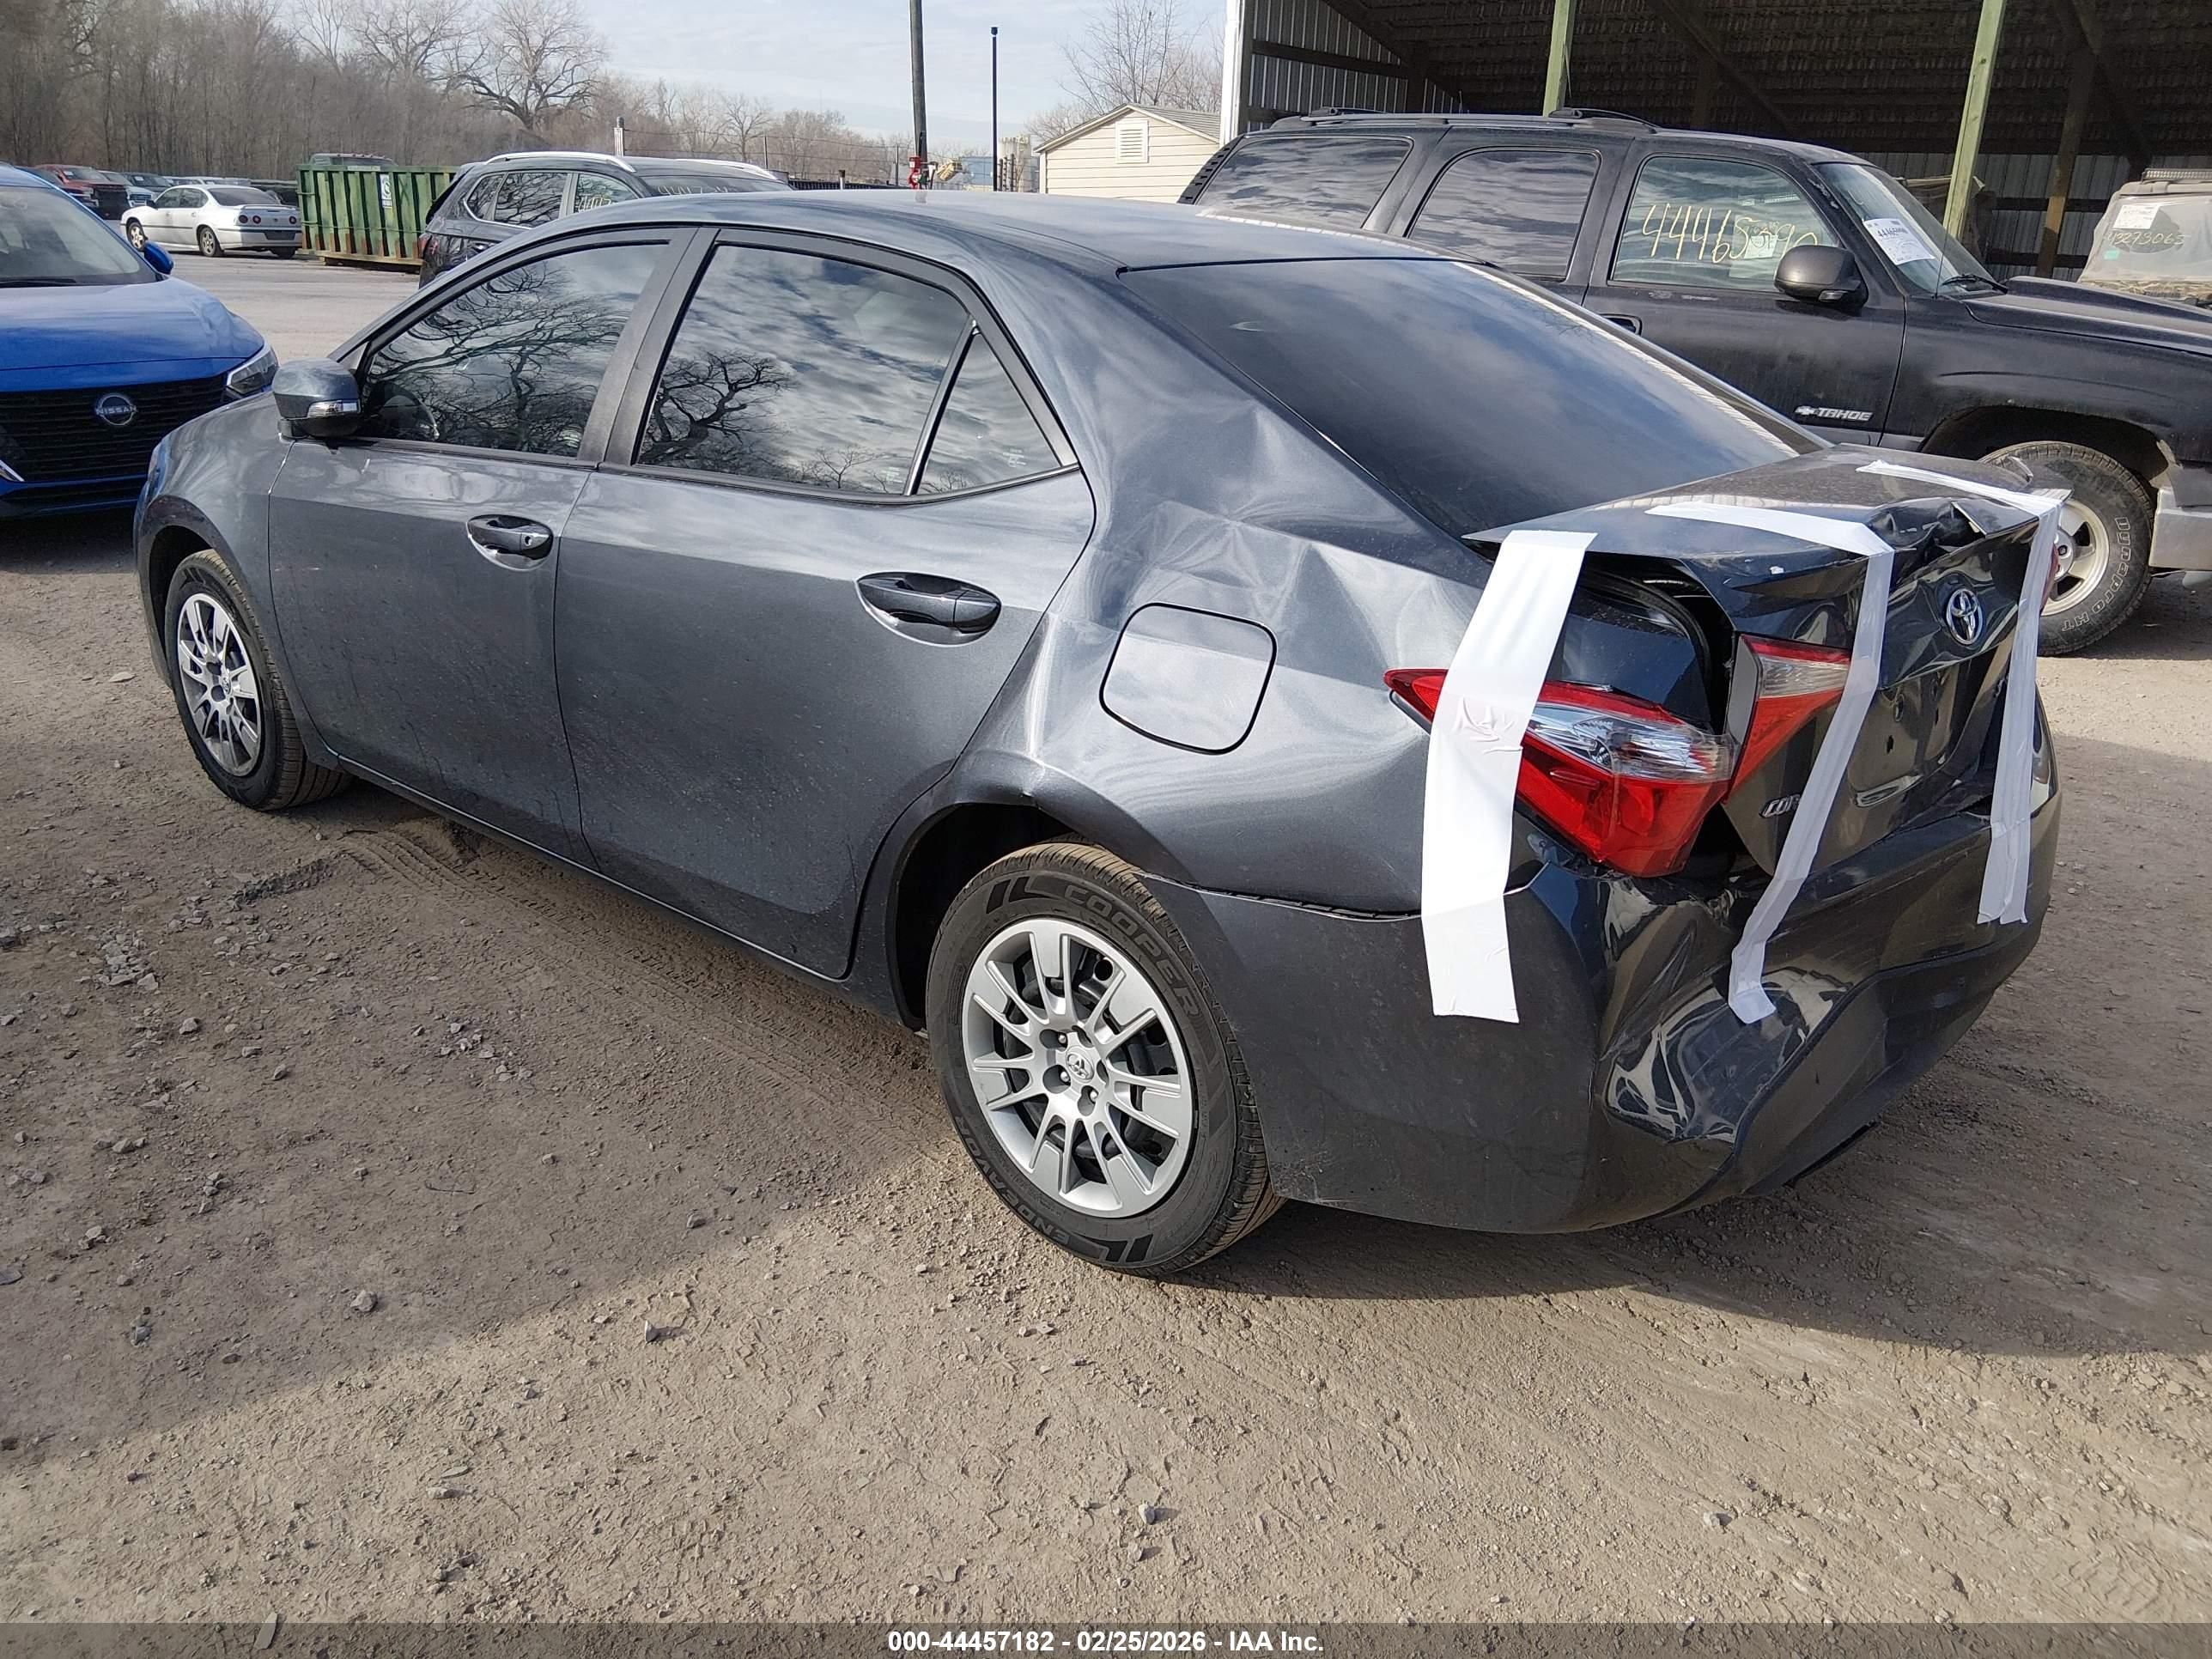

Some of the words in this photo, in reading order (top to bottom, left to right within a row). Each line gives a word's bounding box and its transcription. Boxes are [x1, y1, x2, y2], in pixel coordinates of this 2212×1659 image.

[95, 405, 137, 416] NISSAN
[1817, 407, 1874, 422] TAHOE
[2061, 611, 2090, 632] HT
[1063, 884, 1200, 1018] COOPER
[954, 1115, 1071, 1245] ENDEAVOR
